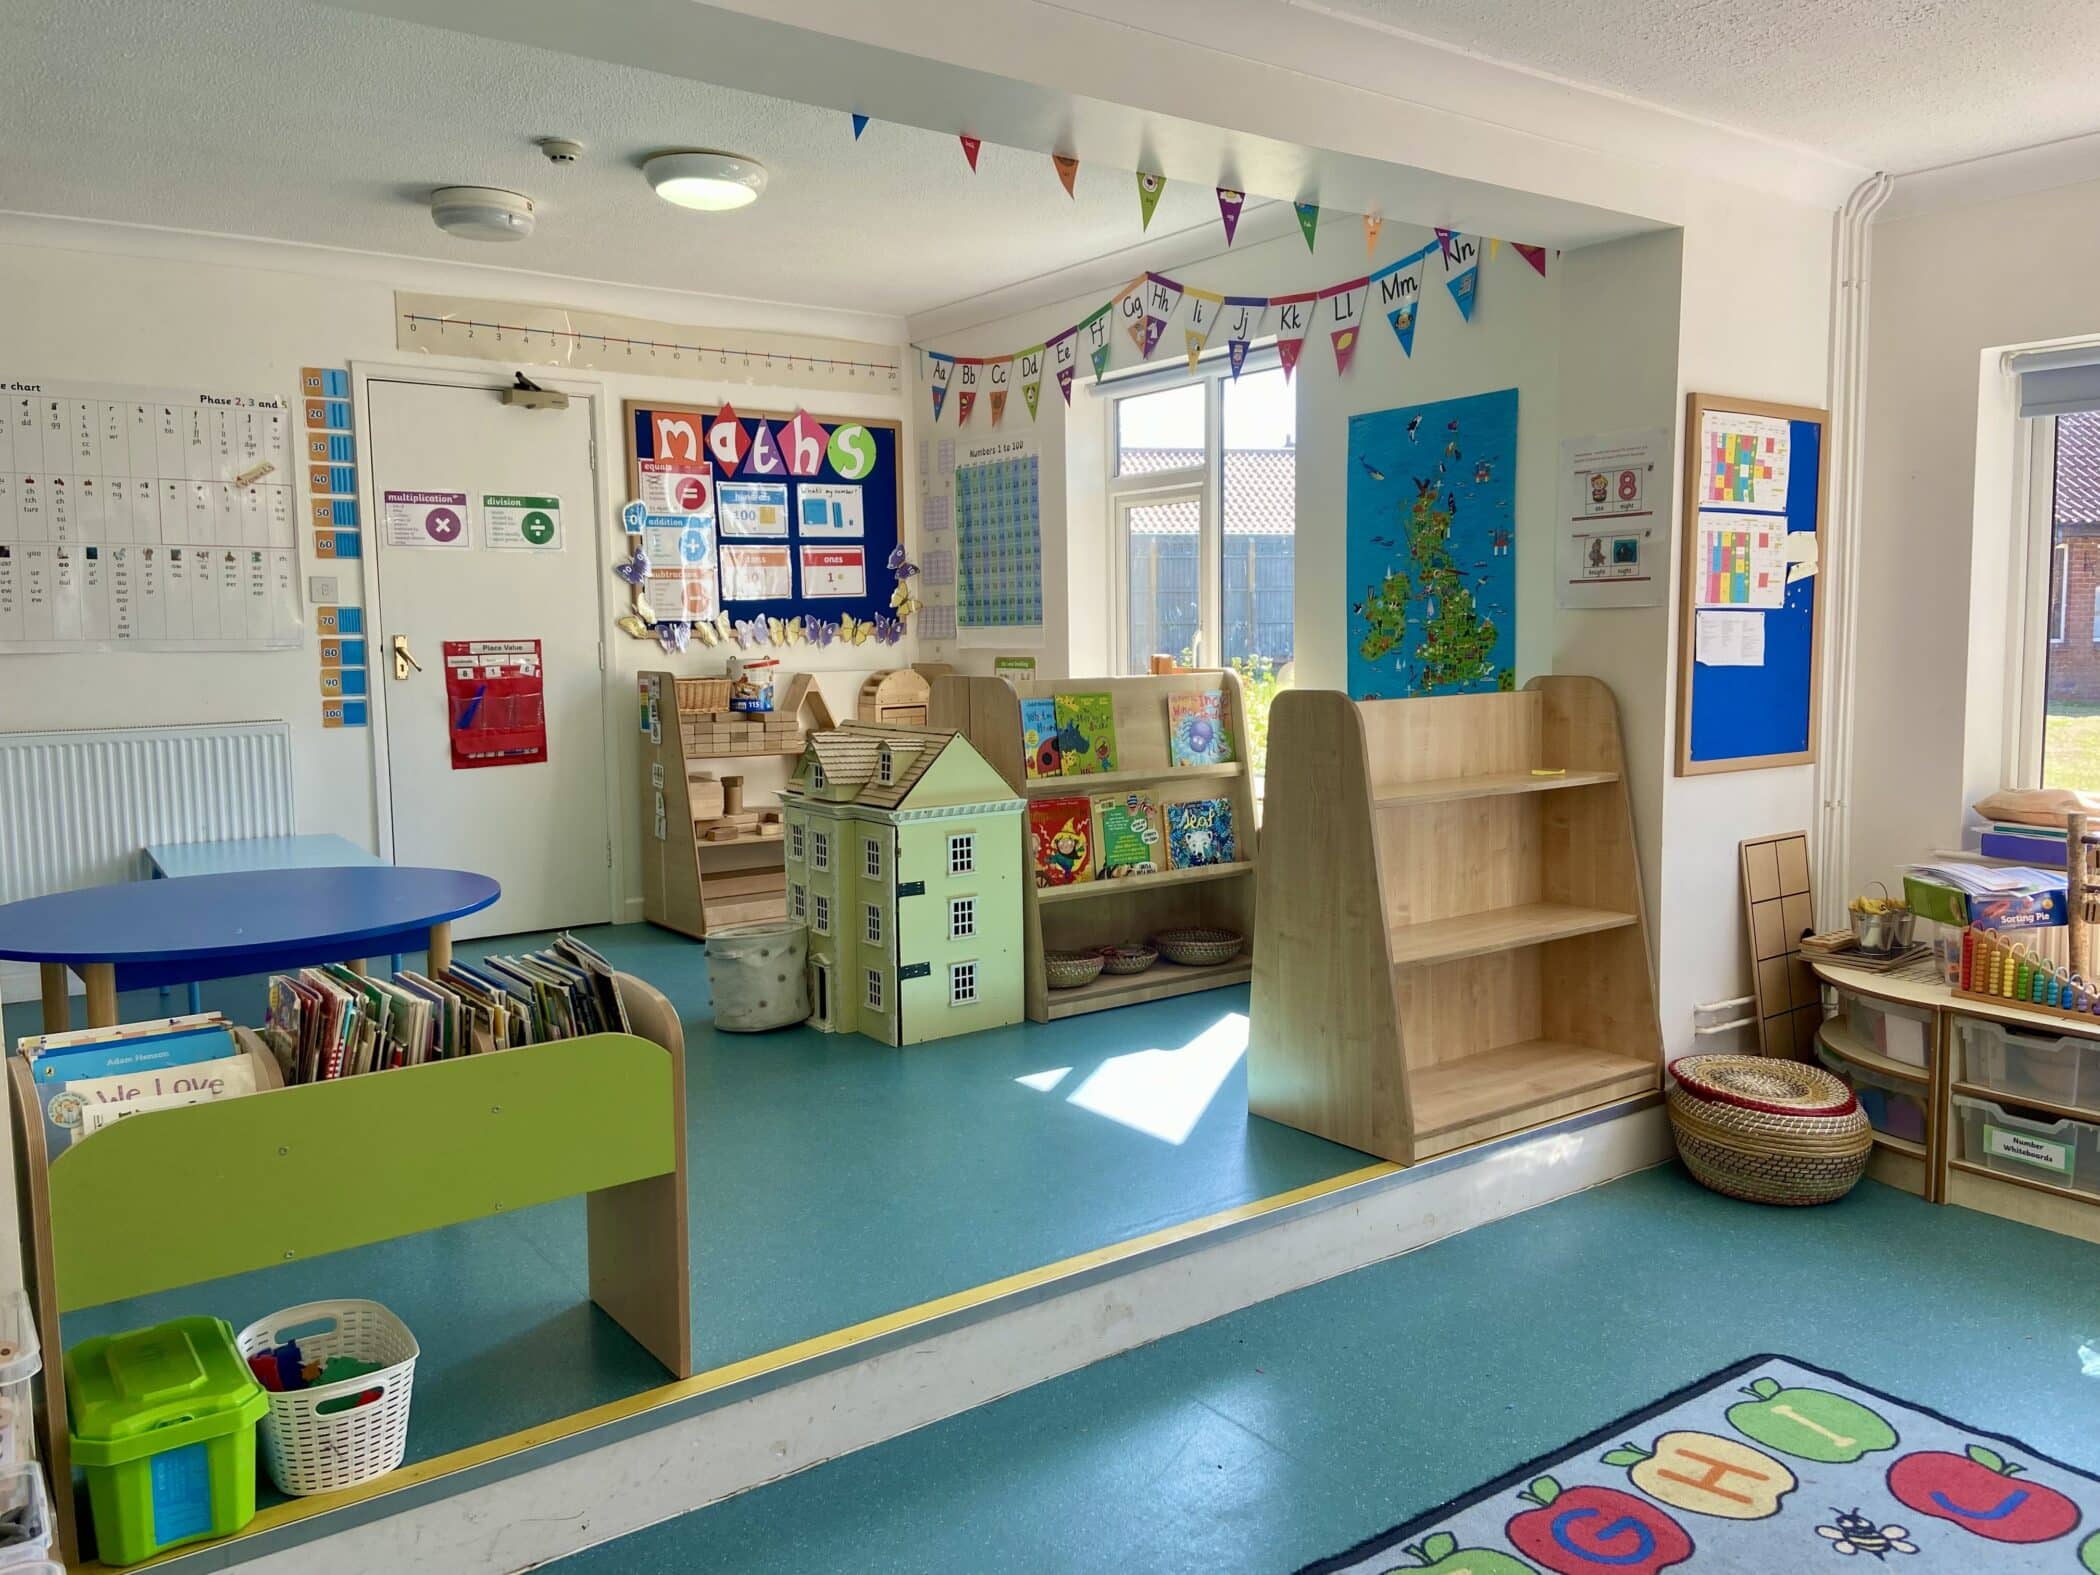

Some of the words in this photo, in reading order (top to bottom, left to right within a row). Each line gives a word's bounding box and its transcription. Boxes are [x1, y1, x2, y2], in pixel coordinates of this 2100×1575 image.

[1442, 239, 1475, 272] Nn
[1381, 272, 1418, 304] Mm
[1152, 285, 1169, 313] Hh
[1334, 292, 1353, 321] Ll
[1233, 308, 1249, 340] Jj
[1280, 304, 1301, 331] Kk
[1090, 317, 1105, 347] Ff
[1057, 342, 1071, 363] Ee
[933, 361, 946, 381] Aa
[1022, 356, 1038, 377] Dd
[962, 365, 976, 385] Bb
[991, 365, 1006, 384] Cc
[10, 382, 41, 392] chart
[307, 378, 320, 386] 10
[200, 394, 232, 405] Phase
[258, 400, 278, 409] and
[309, 410, 322, 418] 20
[312, 443, 326, 451] 30
[969, 446, 996, 458] Numbers
[1003, 443, 1010, 452] to
[1012, 440, 1024, 451] 100
[313, 475, 327, 484] 40
[1618, 470, 1637, 501] 8
[388, 494, 453, 505] multiplication
[487, 498, 521, 507] division
[316, 509, 329, 517] 50
[648, 518, 683, 526] addition
[319, 540, 332, 549] 60
[622, 566, 632, 575] 10
[828, 573, 833, 582] 1
[322, 617, 335, 625] 70
[324, 649, 337, 657] 80
[482, 644, 502, 652] Place
[325, 679, 338, 687] 90
[325, 710, 342, 718] 100
[2000, 914, 2034, 924] Sorting
[2035, 912, 2050, 921] Pie
[106, 1057, 133, 1067] Adam
[96, 1085, 140, 1104] We
[2013, 1137, 2044, 1150] Number
[2003, 1144, 2053, 1162] Whiteboards
[1656, 1447, 1770, 1505] H
[1551, 1507, 1656, 1566] G
